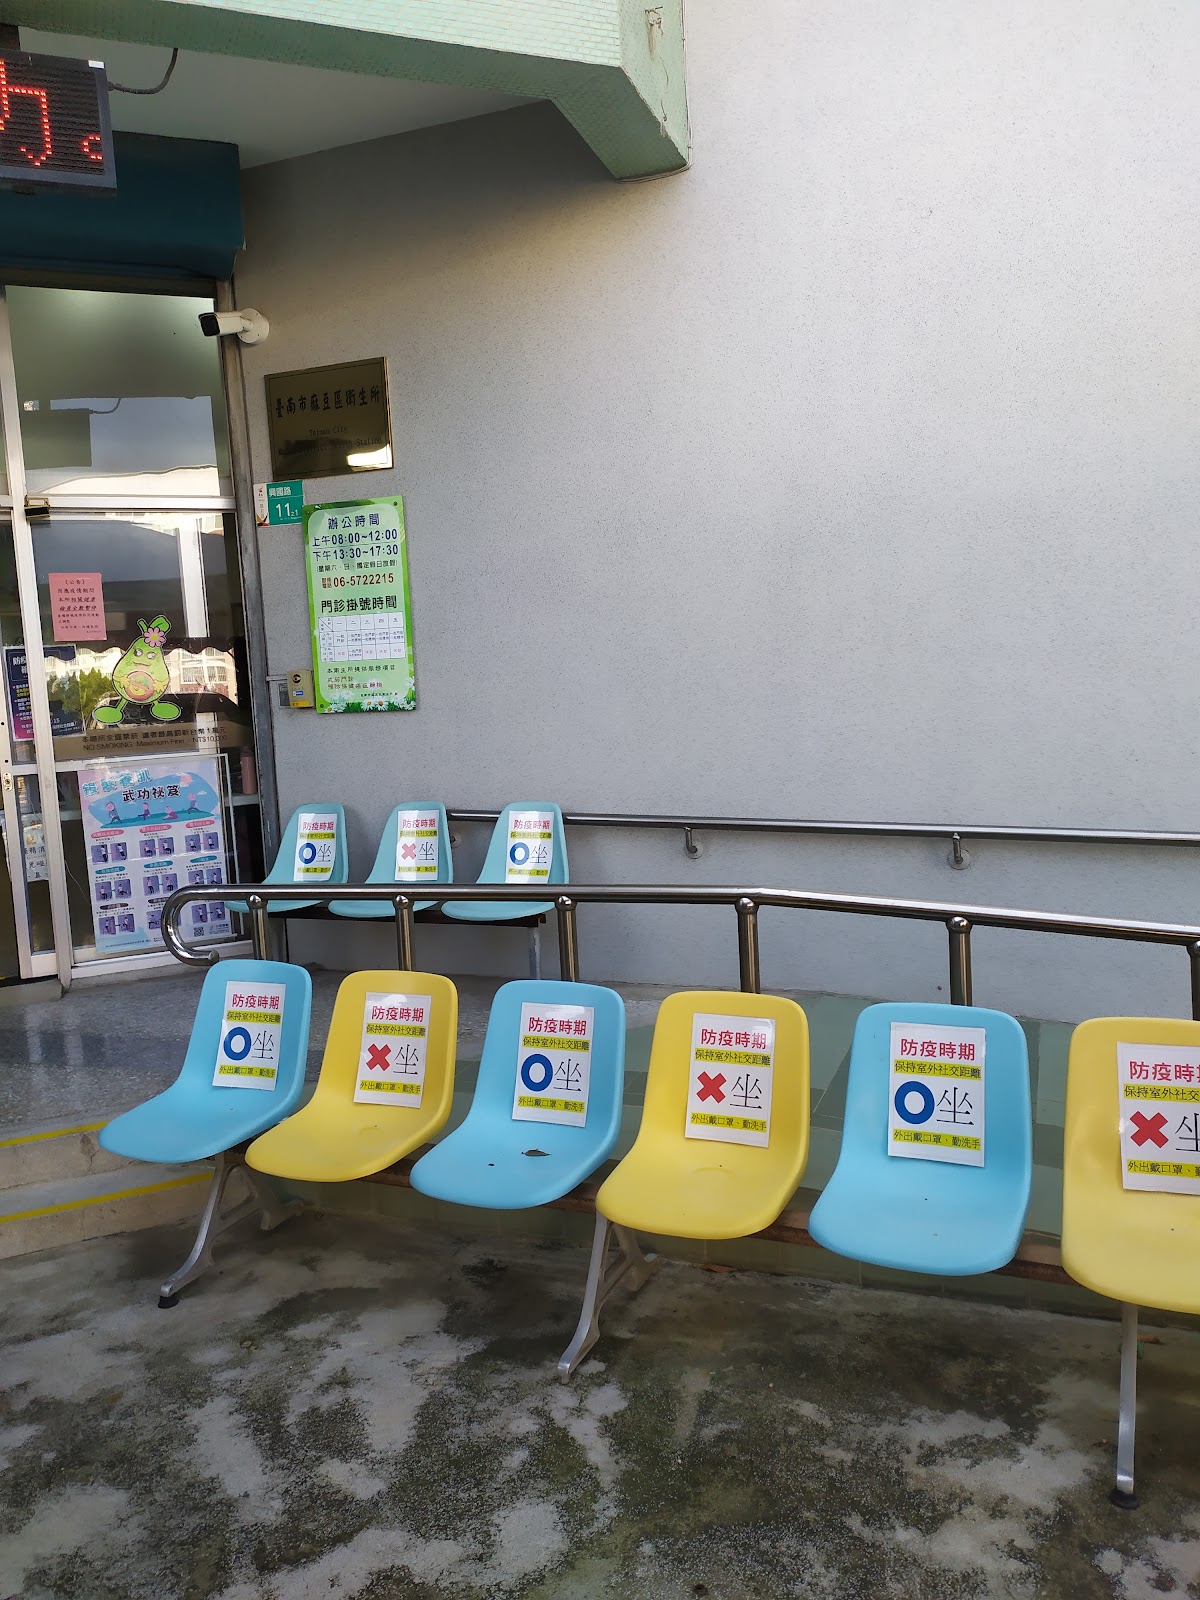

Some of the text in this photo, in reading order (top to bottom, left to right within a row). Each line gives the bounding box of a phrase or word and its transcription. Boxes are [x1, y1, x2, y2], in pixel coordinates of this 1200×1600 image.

[275, 385, 380, 418] 臺南市麻豆區衛生所
[328, 513, 380, 530] 辦公時間
[333, 573, 394, 588] 06-5722215
[320, 595, 397, 613] 門診掛號時間
[96, 741, 132, 750] SMOKING
[402, 818, 435, 828] 防疫時期
[513, 819, 551, 829] 防疫時期
[316, 843, 331, 862] 坐
[418, 841, 435, 861] 坐
[530, 844, 547, 863] 坐
[231, 994, 280, 1010] 防疫時期
[371, 1006, 424, 1022] 防疫時期
[366, 1024, 426, 1037] 保持室外社交距離
[528, 1017, 587, 1036] 防疫時期
[251, 1030, 274, 1060] 坐
[523, 1036, 590, 1051] 保持室外社交距離
[701, 1028, 767, 1050] 防疫時期
[695, 1049, 771, 1066] 保持室外社交距離
[900, 1038, 975, 1061] 防疫時期
[393, 1044, 419, 1075] 坐
[553, 1058, 582, 1092] 坐
[894, 1060, 981, 1079] 保持室外社交距離
[1129, 1061, 1200, 1083] 防疫時
[729, 1073, 763, 1110] 坐
[936, 1086, 975, 1126] 坐
